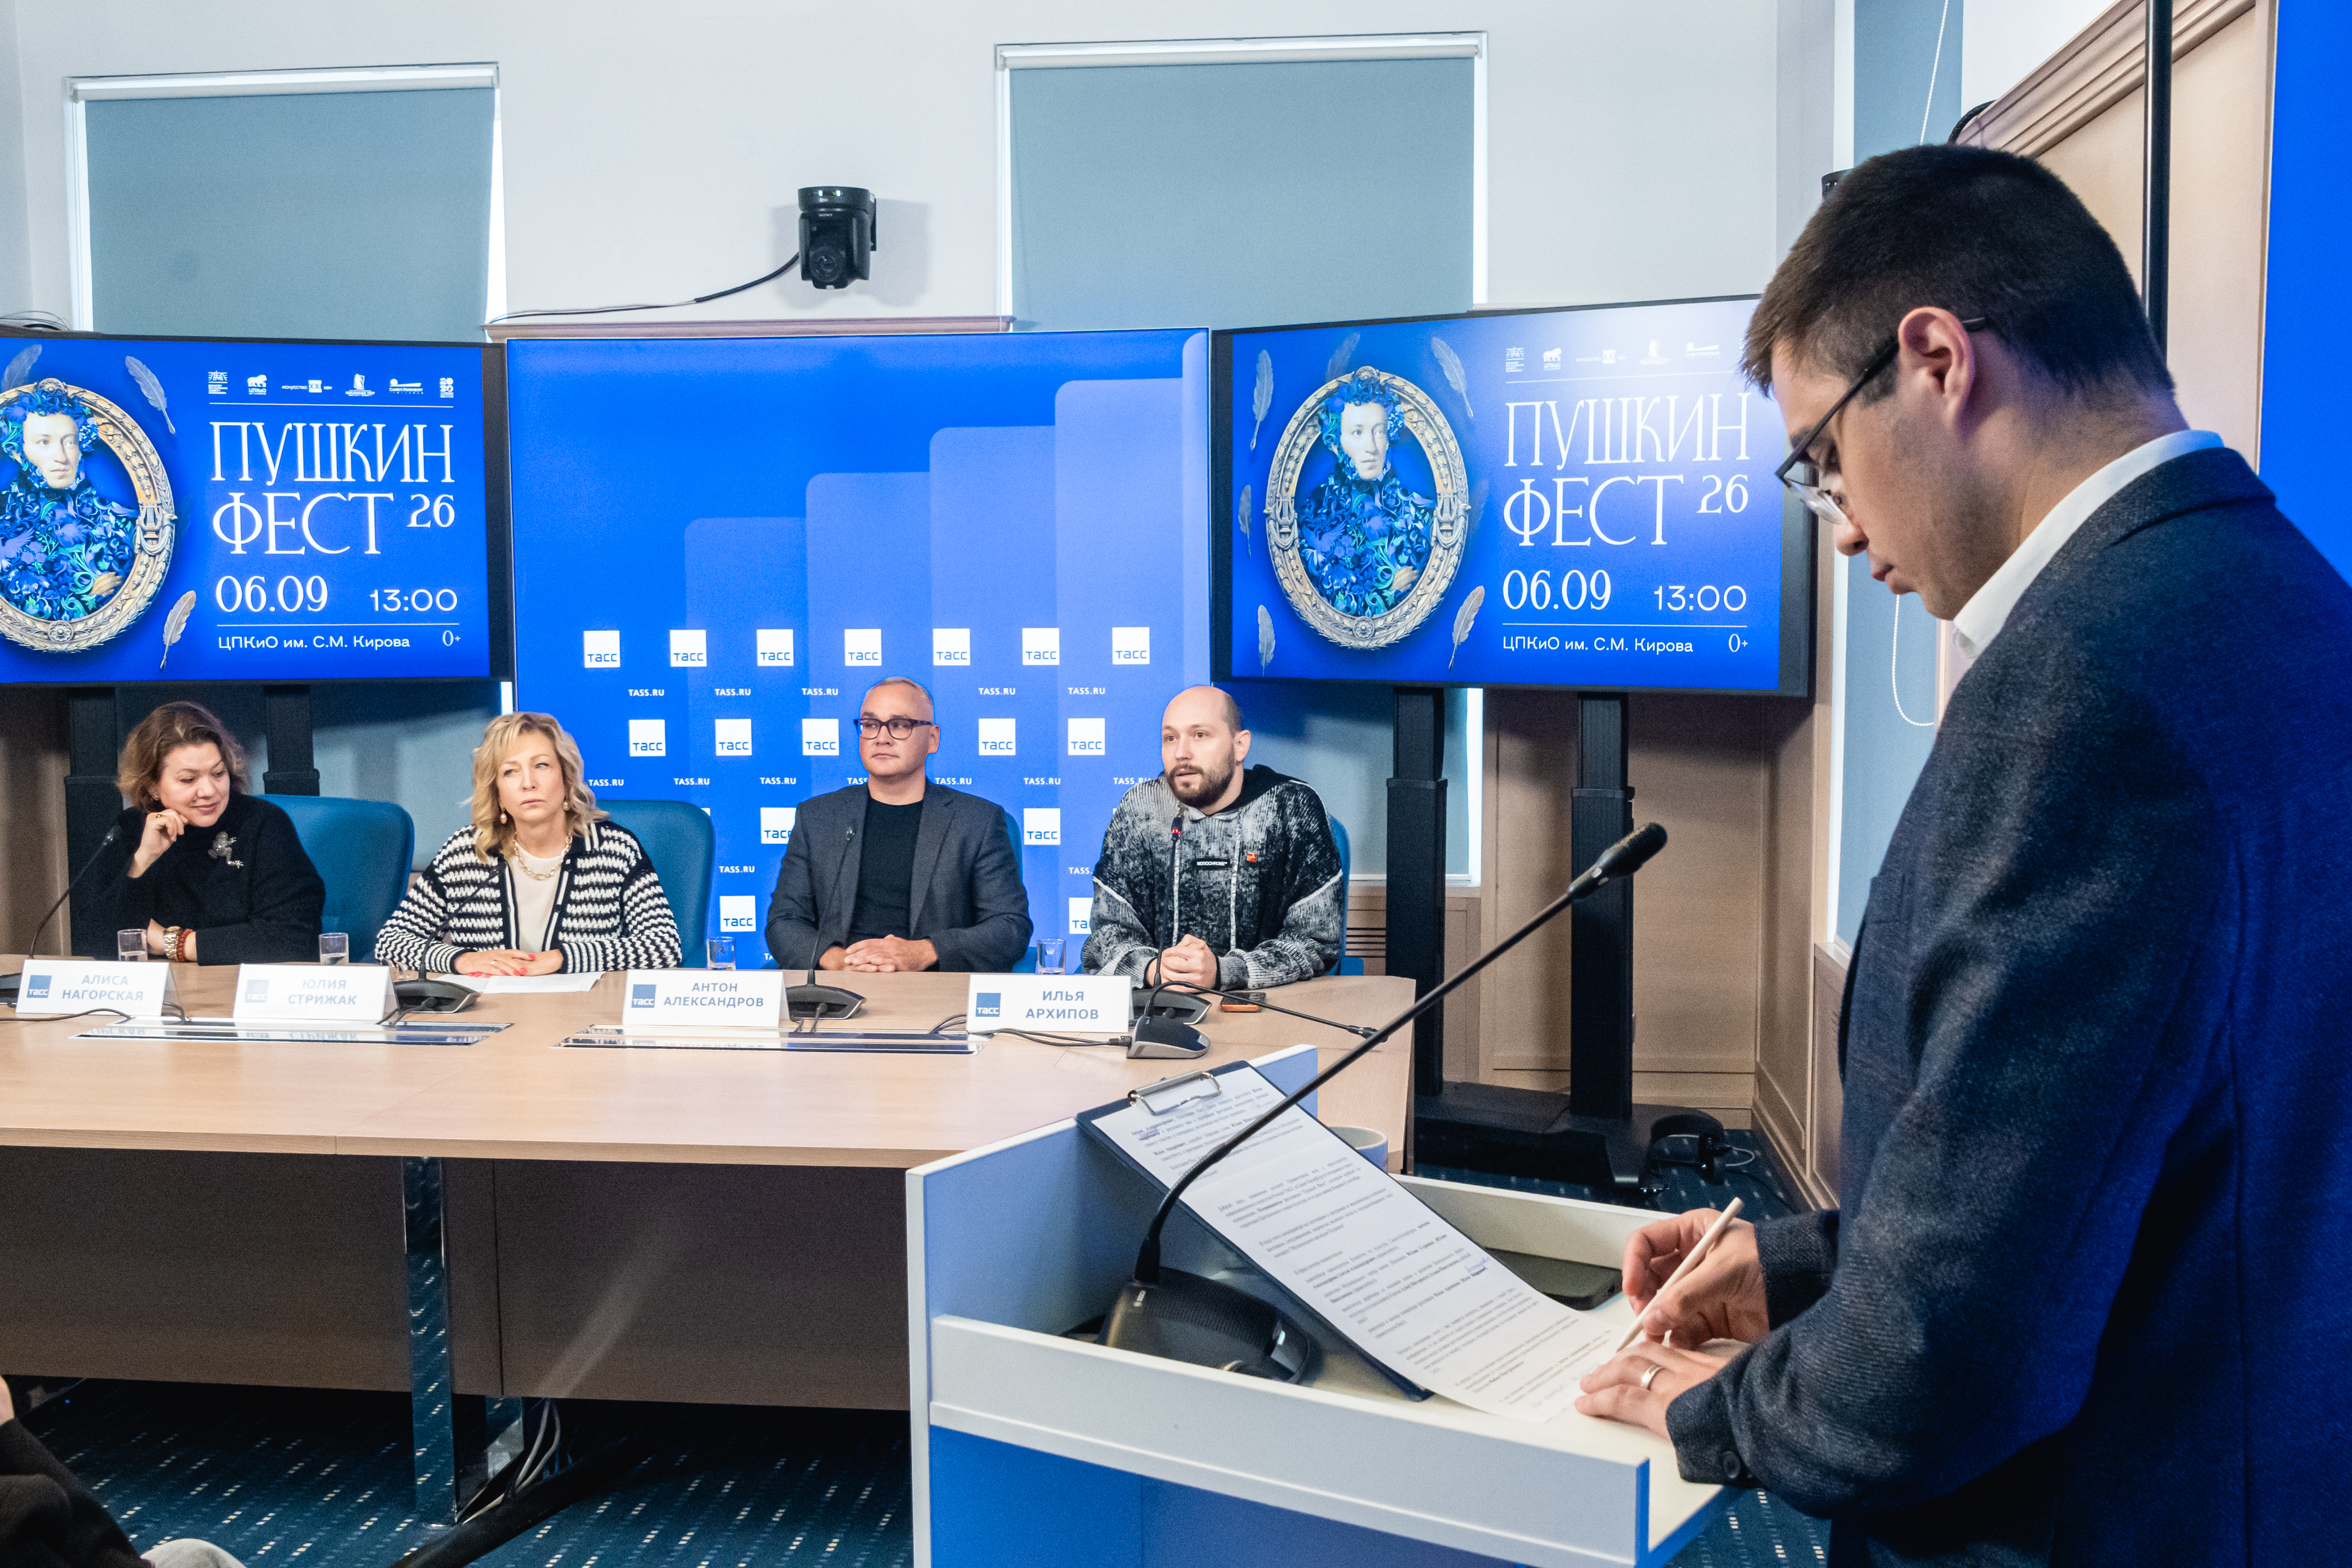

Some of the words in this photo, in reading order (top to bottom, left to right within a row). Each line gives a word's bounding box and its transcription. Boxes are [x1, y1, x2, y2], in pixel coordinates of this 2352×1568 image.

[1504, 392, 1752, 470] ПУШКИН
[209, 421, 455, 486] ПУШКИН
[1503, 474, 1684, 547] ФЕСТ
[1695, 473, 1749, 514] 26
[212, 492, 394, 555] ФЕСТ
[406, 494, 455, 528] 26
[215, 575, 328, 612] 06.09
[369, 589, 458, 612] 13:00
[1502, 569, 1611, 611] 06.09
[1654, 585, 1747, 612] 13:00
[218, 636, 279, 650] ЦПКиО
[284, 639, 307, 648] им.
[312, 635, 348, 648] С.М.
[353, 635, 411, 650] Кирова
[442, 630, 461, 646] 0+
[1728, 633, 1749, 652] 0+
[1503, 636, 1560, 652] ЦПКиО
[1565, 641, 1588, 650] им.
[1594, 637, 1629, 651] С.М.
[1635, 638, 1694, 655] Кирова
[628, 688, 665, 697] TASS.RU
[714, 688, 752, 696] TASS.RU
[81, 974, 129, 986] АЛИСА
[303, 979, 347, 990] ЮЛИЯ
[692, 982, 737, 992] АНТОН
[62, 989, 143, 1001] НАГОРСКАЯ
[288, 994, 357, 1005] СТРИЖАК
[1042, 990, 1084, 1001] ИЛЬЯ
[663, 997, 764, 1008] АЛЕКСАНДРОВ
[1025, 1008, 1099, 1019] АРХИПОВ
